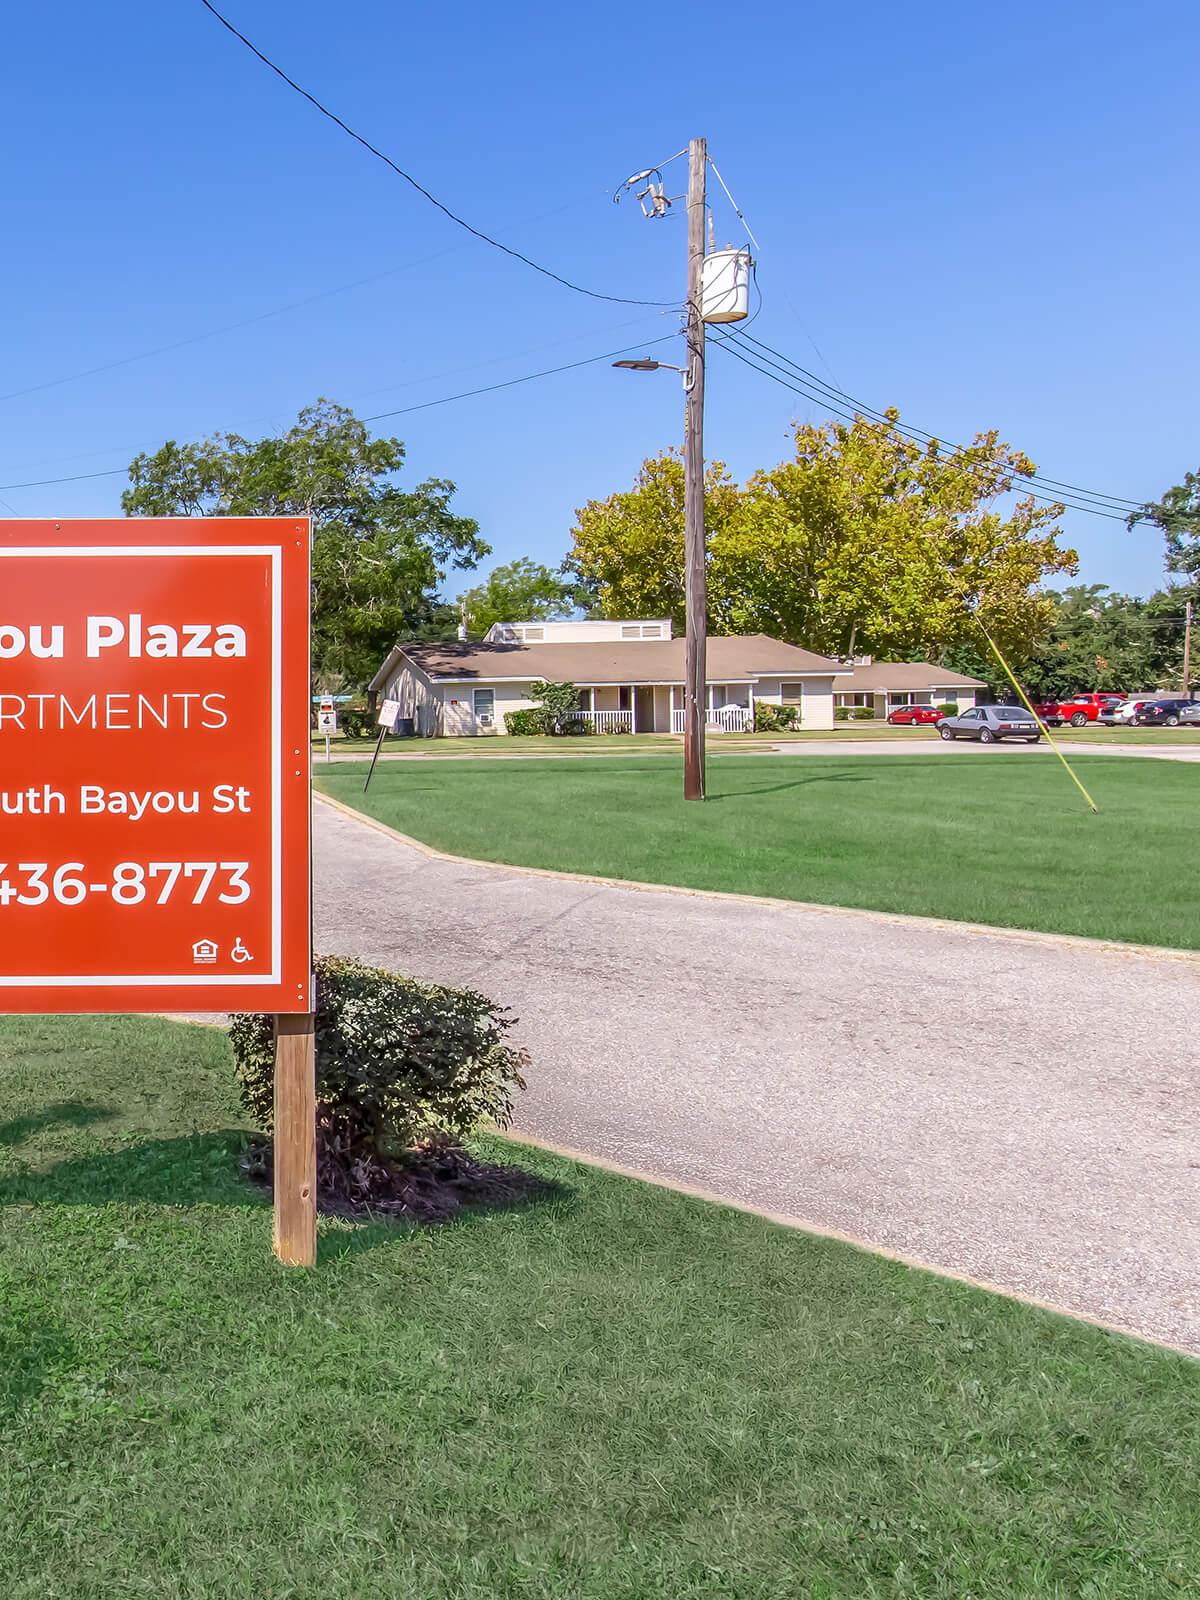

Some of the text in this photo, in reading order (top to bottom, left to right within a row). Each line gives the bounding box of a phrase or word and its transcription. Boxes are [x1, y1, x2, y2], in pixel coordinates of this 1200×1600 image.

[86, 613, 247, 658] Plaza
[80, 785, 200, 821] Bayou
[212, 784, 252, 813] St
